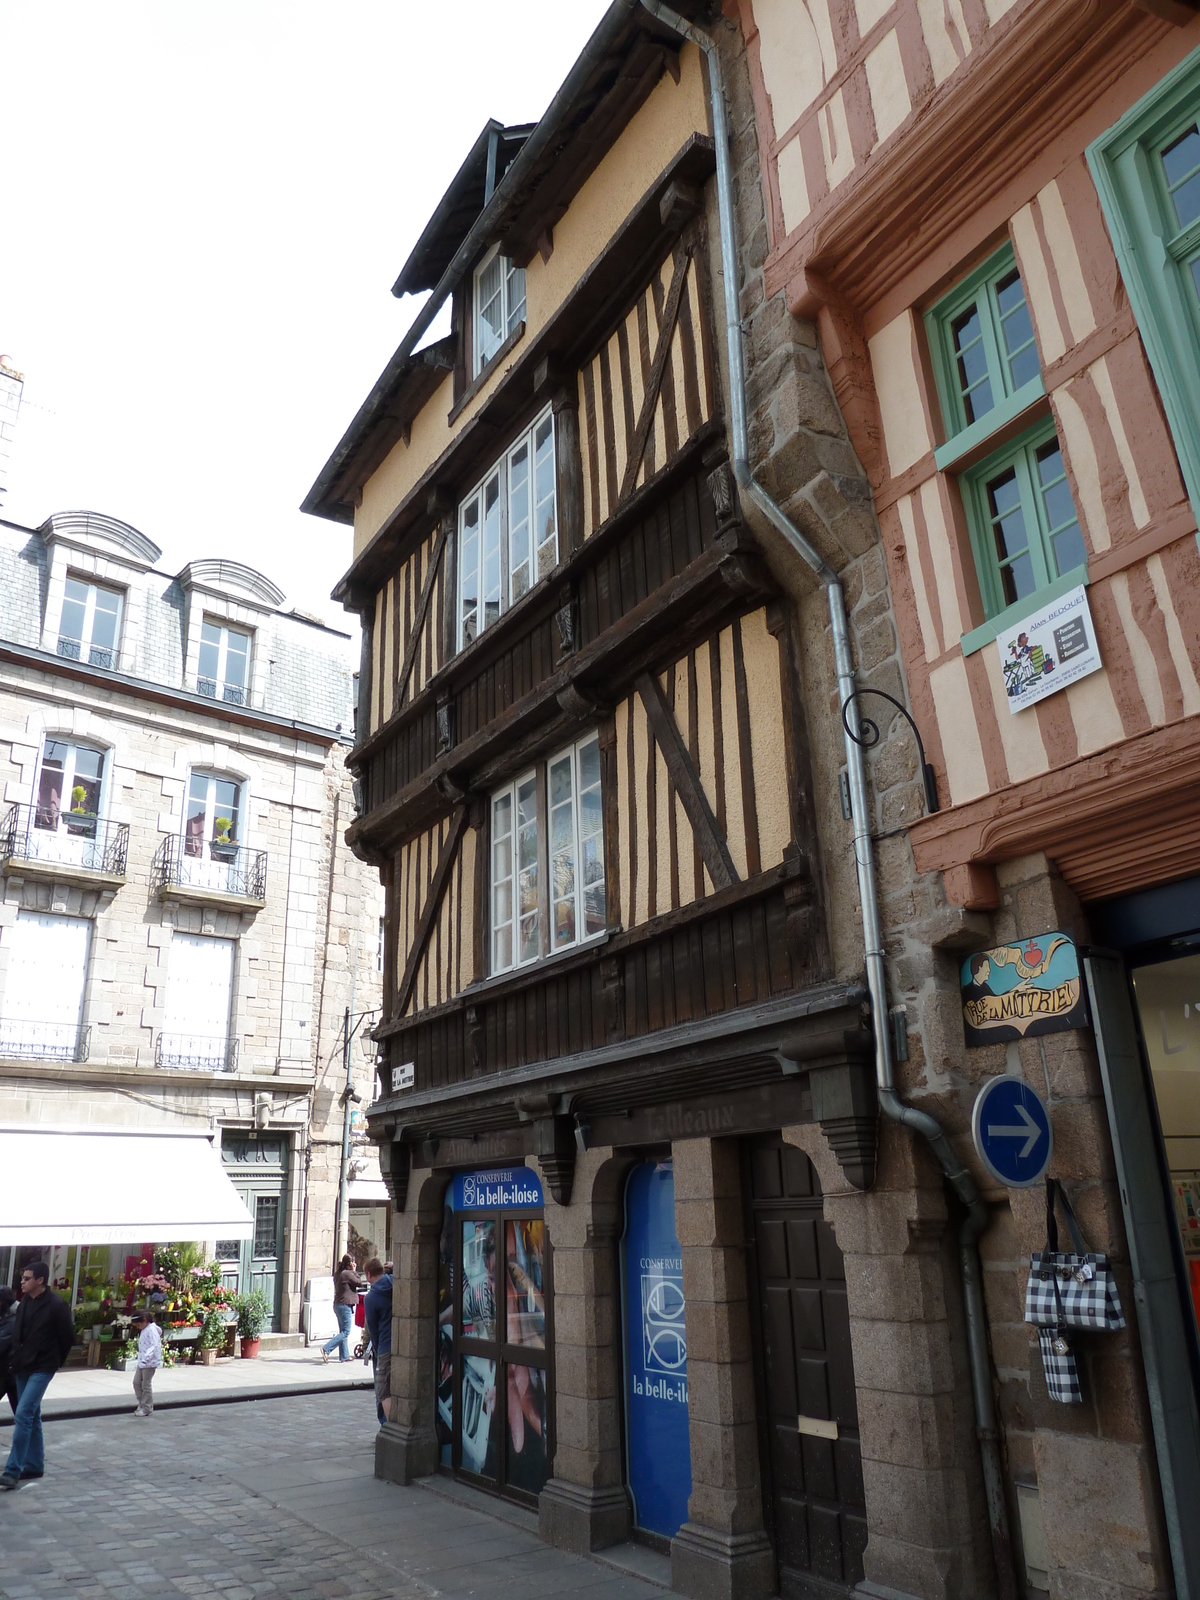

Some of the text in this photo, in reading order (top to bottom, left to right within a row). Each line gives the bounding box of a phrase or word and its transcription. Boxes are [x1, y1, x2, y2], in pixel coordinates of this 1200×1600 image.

[971, 998, 988, 1016] RUE
[976, 1011, 988, 1024] DE
[989, 1006, 999, 1019] LA
[476, 1172, 513, 1184] CONSERVERIE
[476, 1184, 538, 1205] la belle-iloise
[640, 1258, 682, 1270] CONSERVE
[633, 1375, 643, 1395] la
